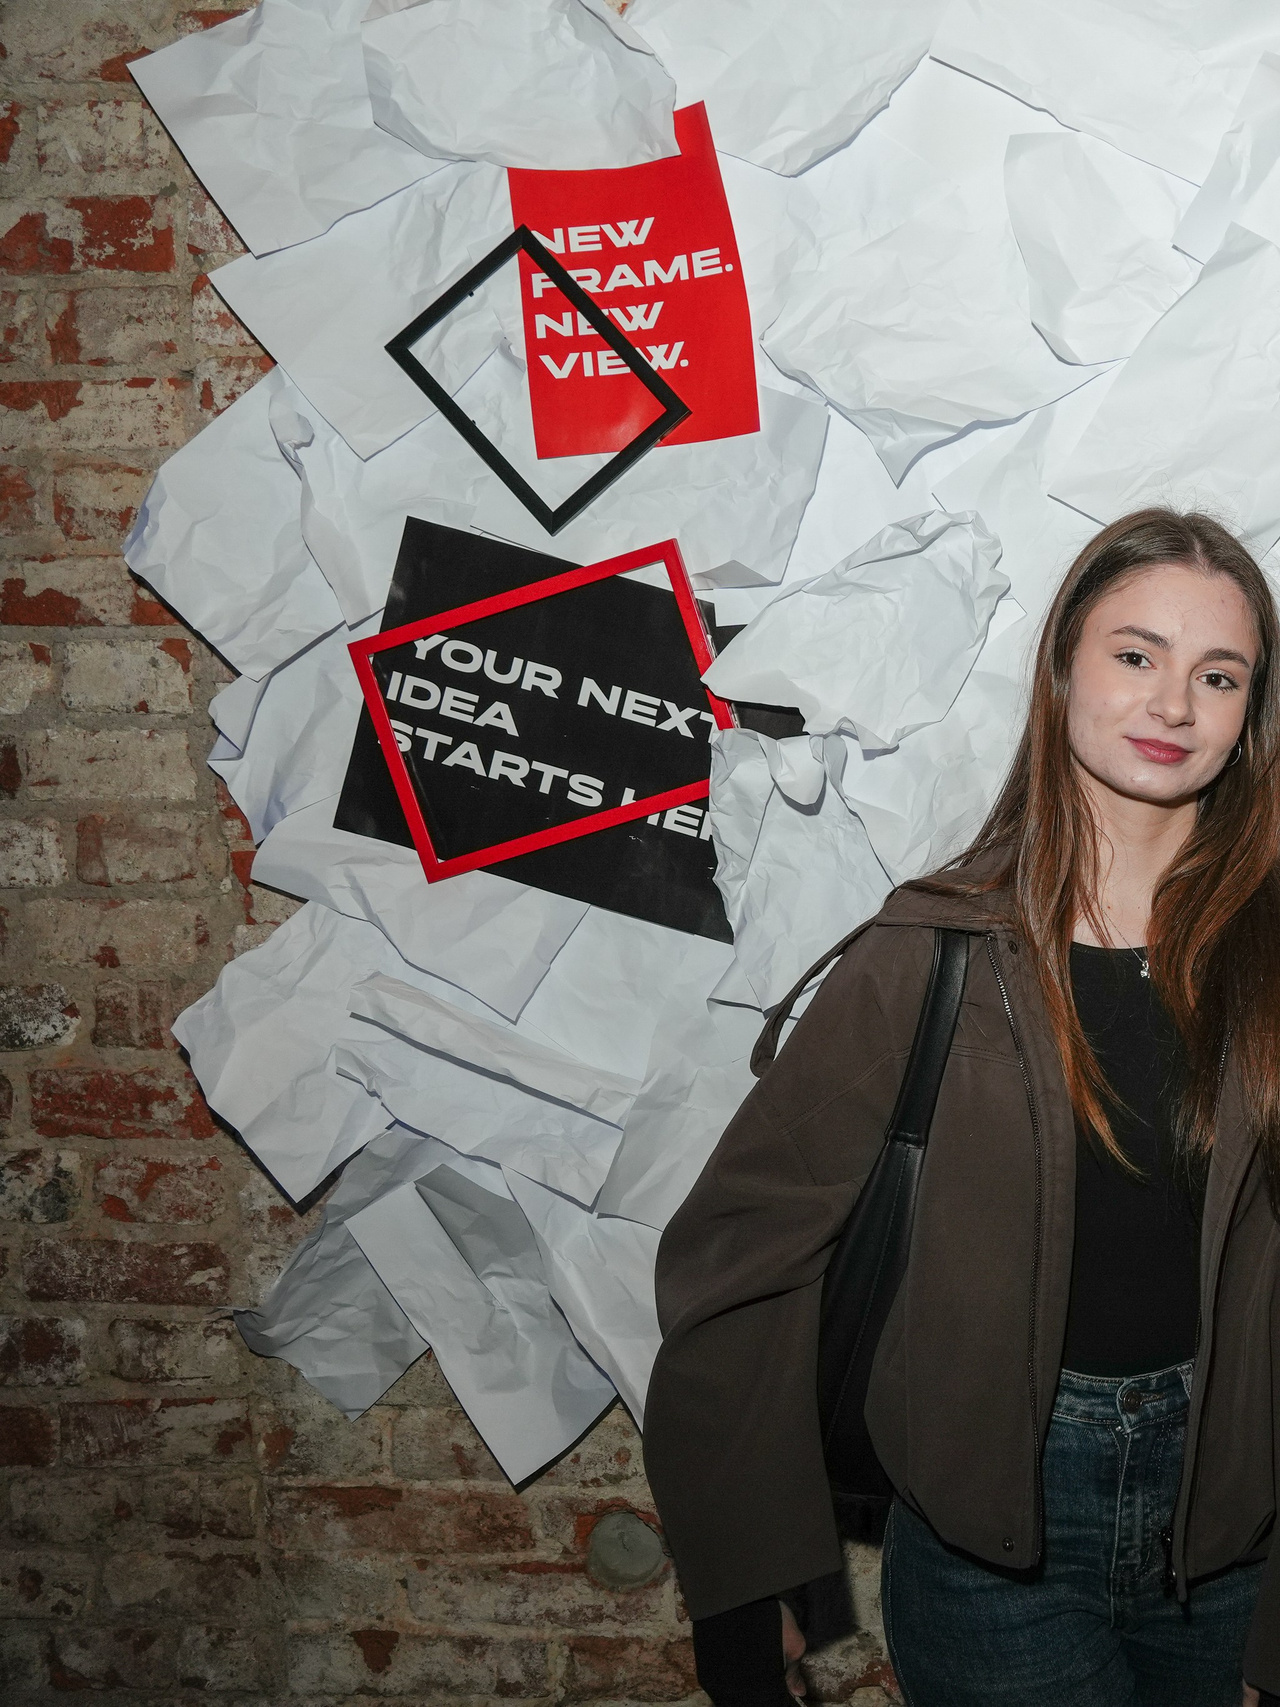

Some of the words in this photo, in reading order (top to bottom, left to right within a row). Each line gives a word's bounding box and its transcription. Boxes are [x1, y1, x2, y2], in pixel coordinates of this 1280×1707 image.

[531, 216, 655, 254] NEW
[531, 247, 734, 298] FRAME.
[539, 341, 689, 379] VIEW.
[413, 634, 563, 700] YOUR
[386, 670, 520, 737] IDEA
[378, 718, 605, 808] STARTS
